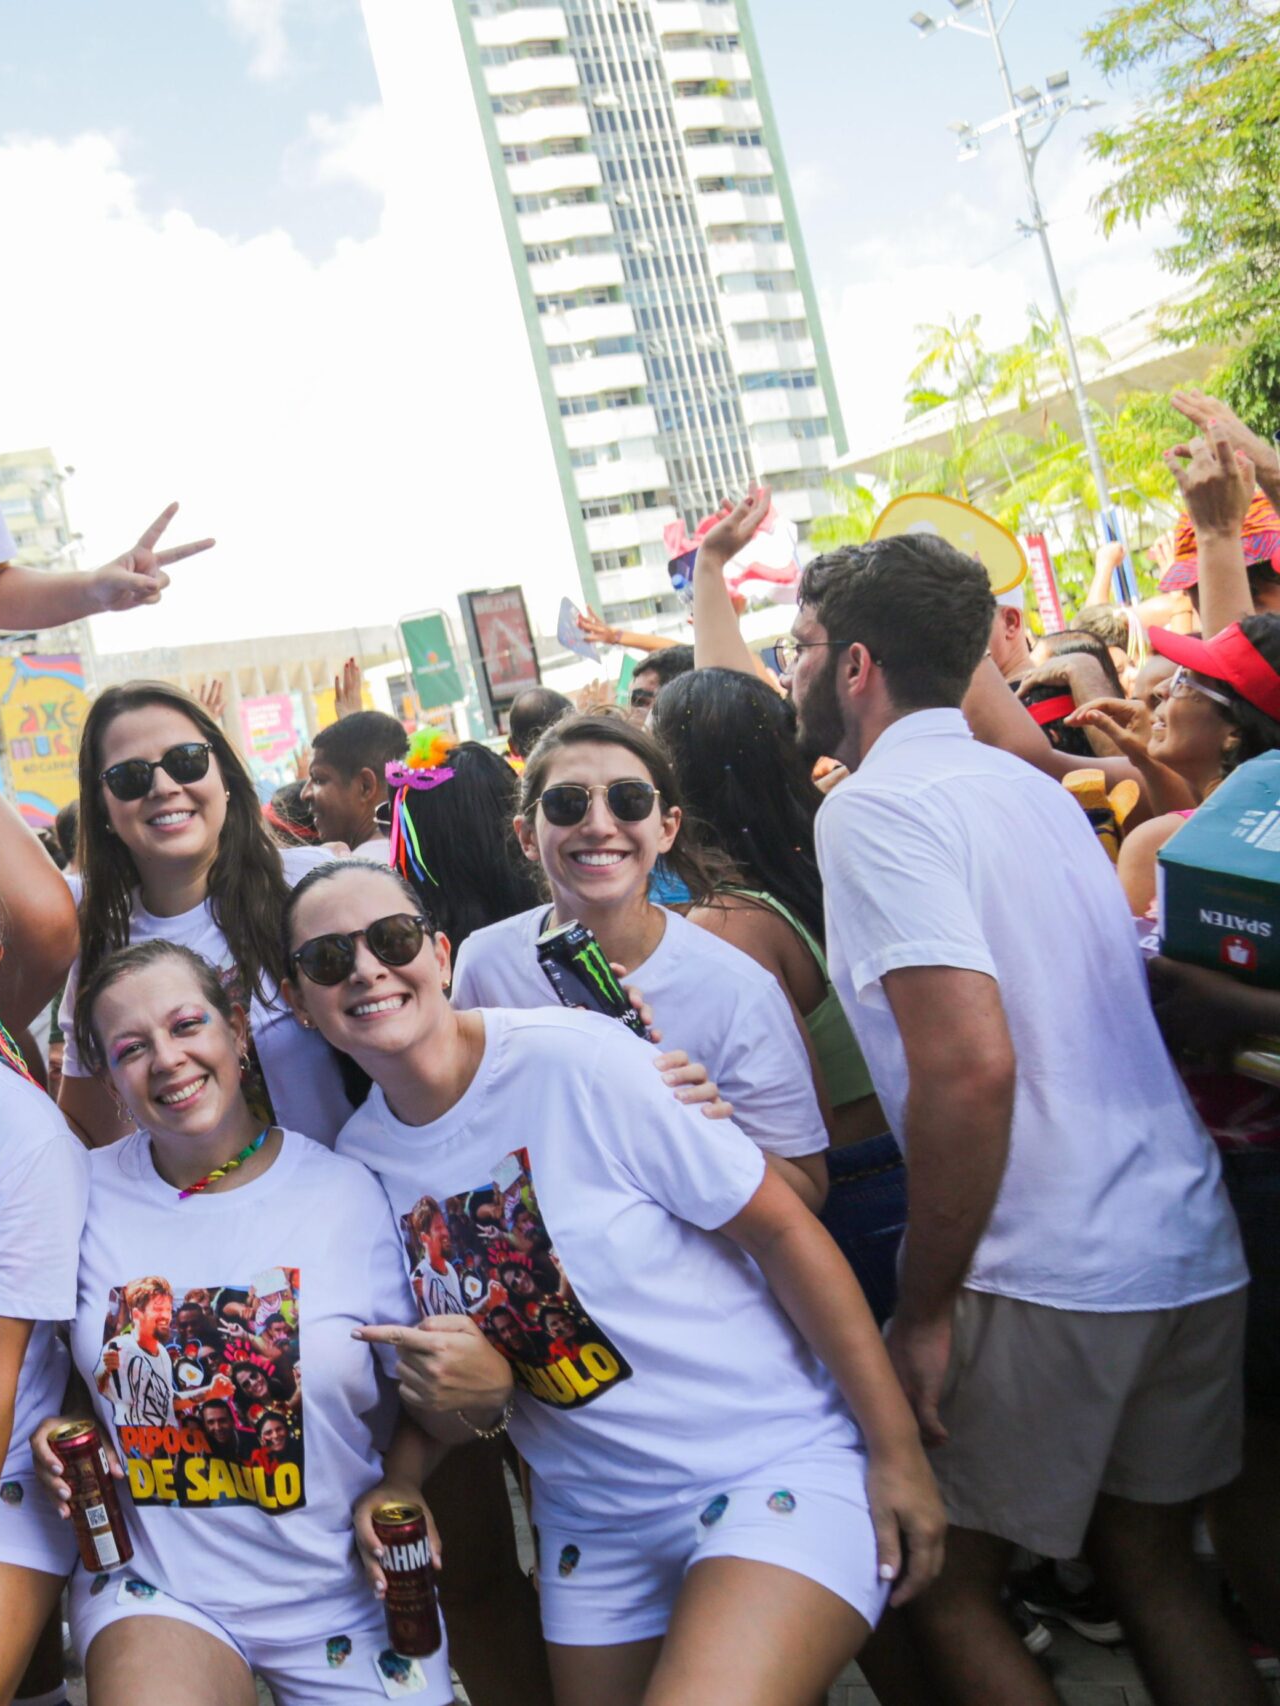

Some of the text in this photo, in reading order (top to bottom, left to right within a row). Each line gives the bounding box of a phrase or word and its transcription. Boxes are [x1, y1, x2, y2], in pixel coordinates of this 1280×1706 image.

[1199, 907, 1273, 937] SPATEN
[120, 1426, 213, 1455] PIPOCA
[127, 1458, 178, 1499] DE
[184, 1457, 301, 1508] SAULO
